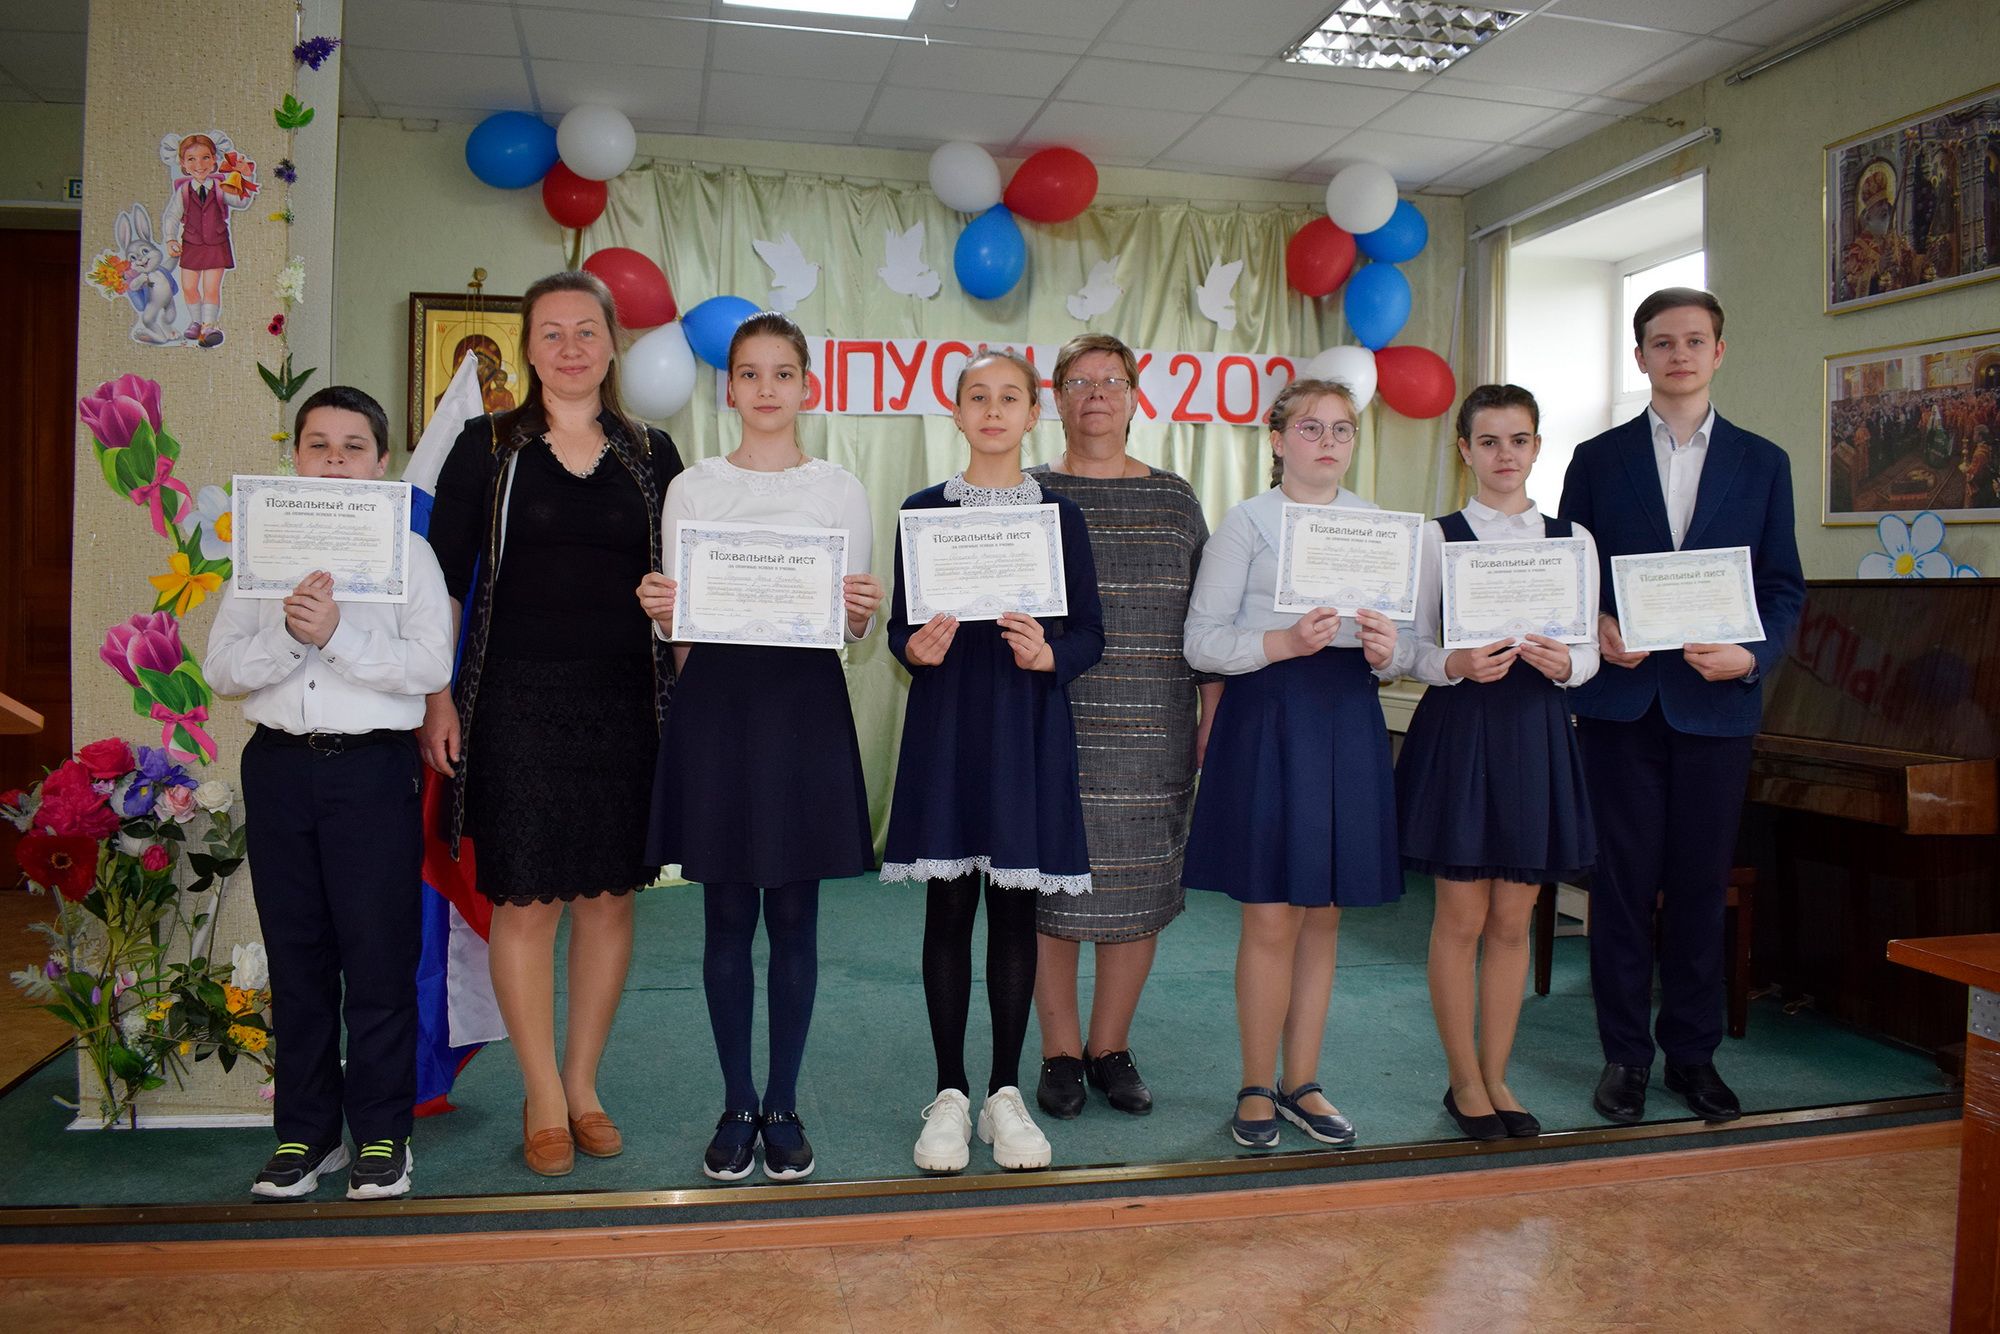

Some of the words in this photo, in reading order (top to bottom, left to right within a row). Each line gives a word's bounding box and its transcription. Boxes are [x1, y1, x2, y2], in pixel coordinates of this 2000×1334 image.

[265, 497, 344, 511] Похвальный
[348, 502, 377, 512] лист
[933, 531, 1003, 544] Похвальный
[1006, 531, 1031, 541] лист
[1310, 523, 1373, 536] Похвальный
[1376, 529, 1398, 539] лист
[709, 550, 785, 564] Похвальный
[788, 555, 816, 565] лист
[1470, 557, 1536, 569] Похвальный
[1539, 557, 1562, 566] лист
